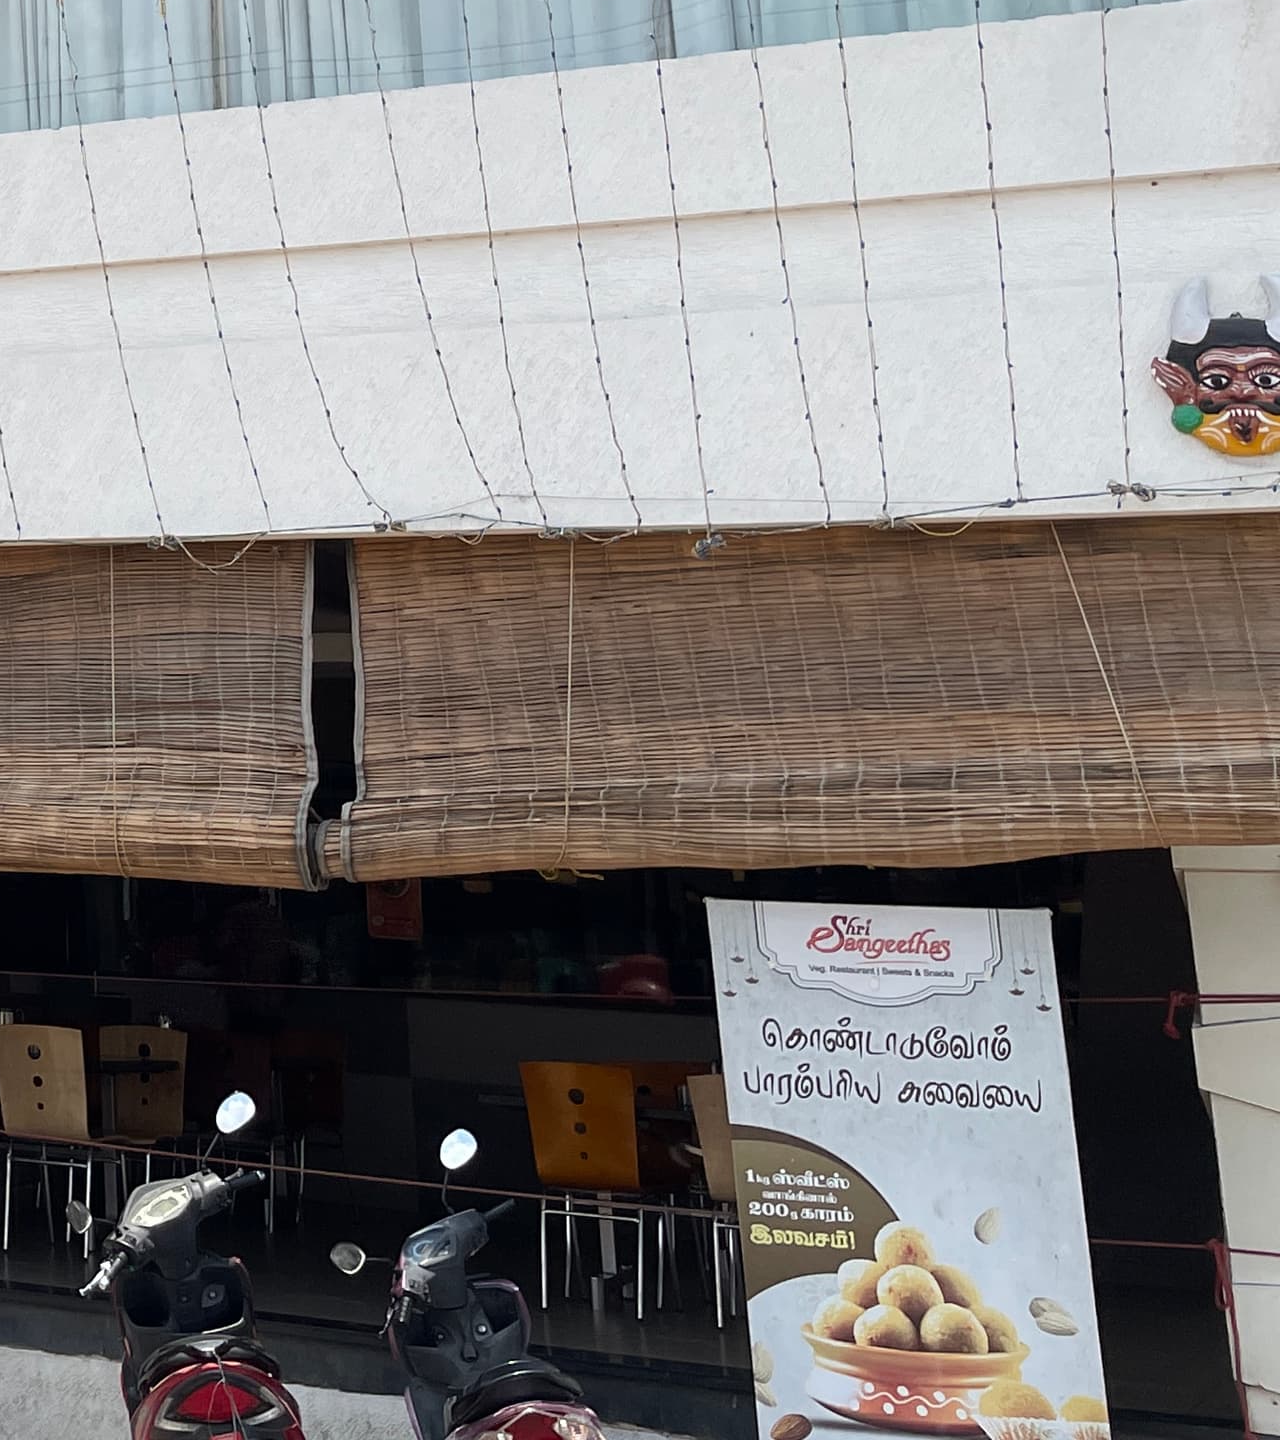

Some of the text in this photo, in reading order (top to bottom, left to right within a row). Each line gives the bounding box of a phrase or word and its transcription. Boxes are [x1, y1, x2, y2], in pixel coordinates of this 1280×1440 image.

[761, 1016, 1012, 1062] கொண்டாடுவோம்
[743, 1062, 1042, 1113] பாரம்பரிய சுவையை
[800, 1205, 855, 1222] காரம்
